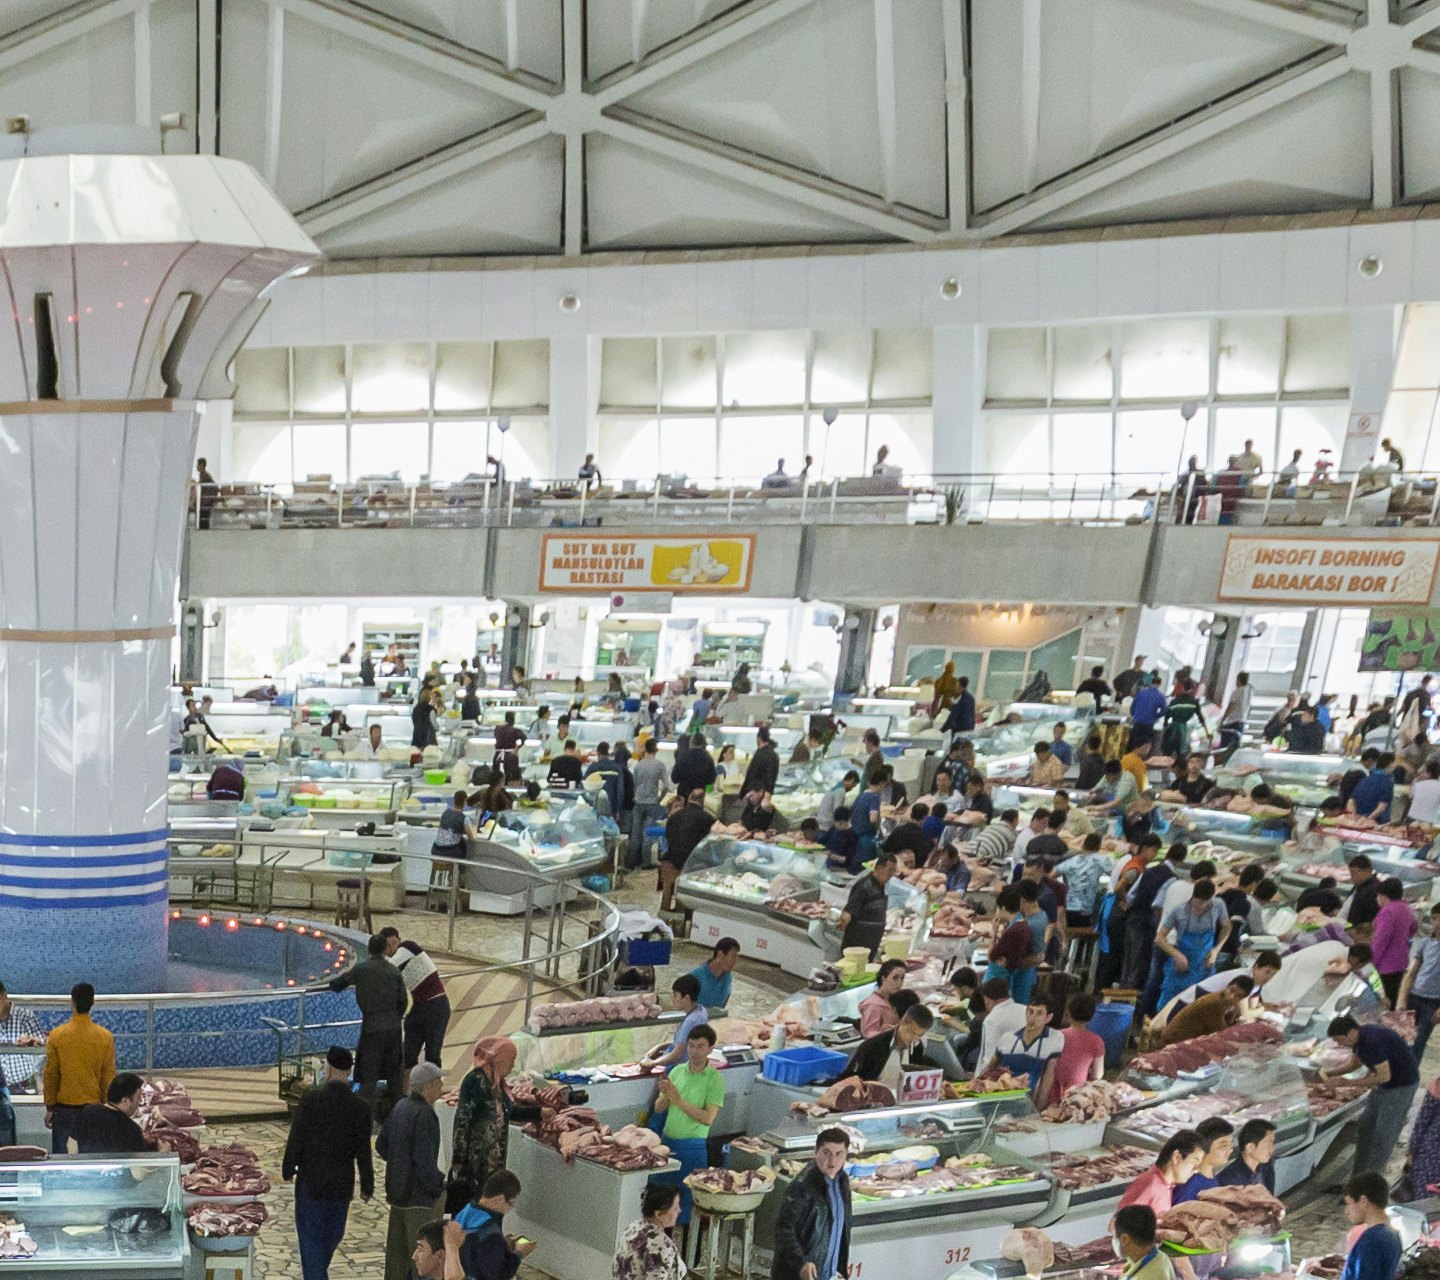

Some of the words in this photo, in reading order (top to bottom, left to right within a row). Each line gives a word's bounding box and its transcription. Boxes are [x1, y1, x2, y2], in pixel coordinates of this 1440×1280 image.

[1254, 548, 1317, 565] INSOFI
[1319, 548, 1407, 567] BORNING
[1251, 573, 1343, 590] BARAKASI
[1346, 575, 1387, 593] BOR
[915, 1073, 942, 1090] ОТ
[944, 1246, 971, 1265] 312
[837, 1261, 863, 1279] 11
